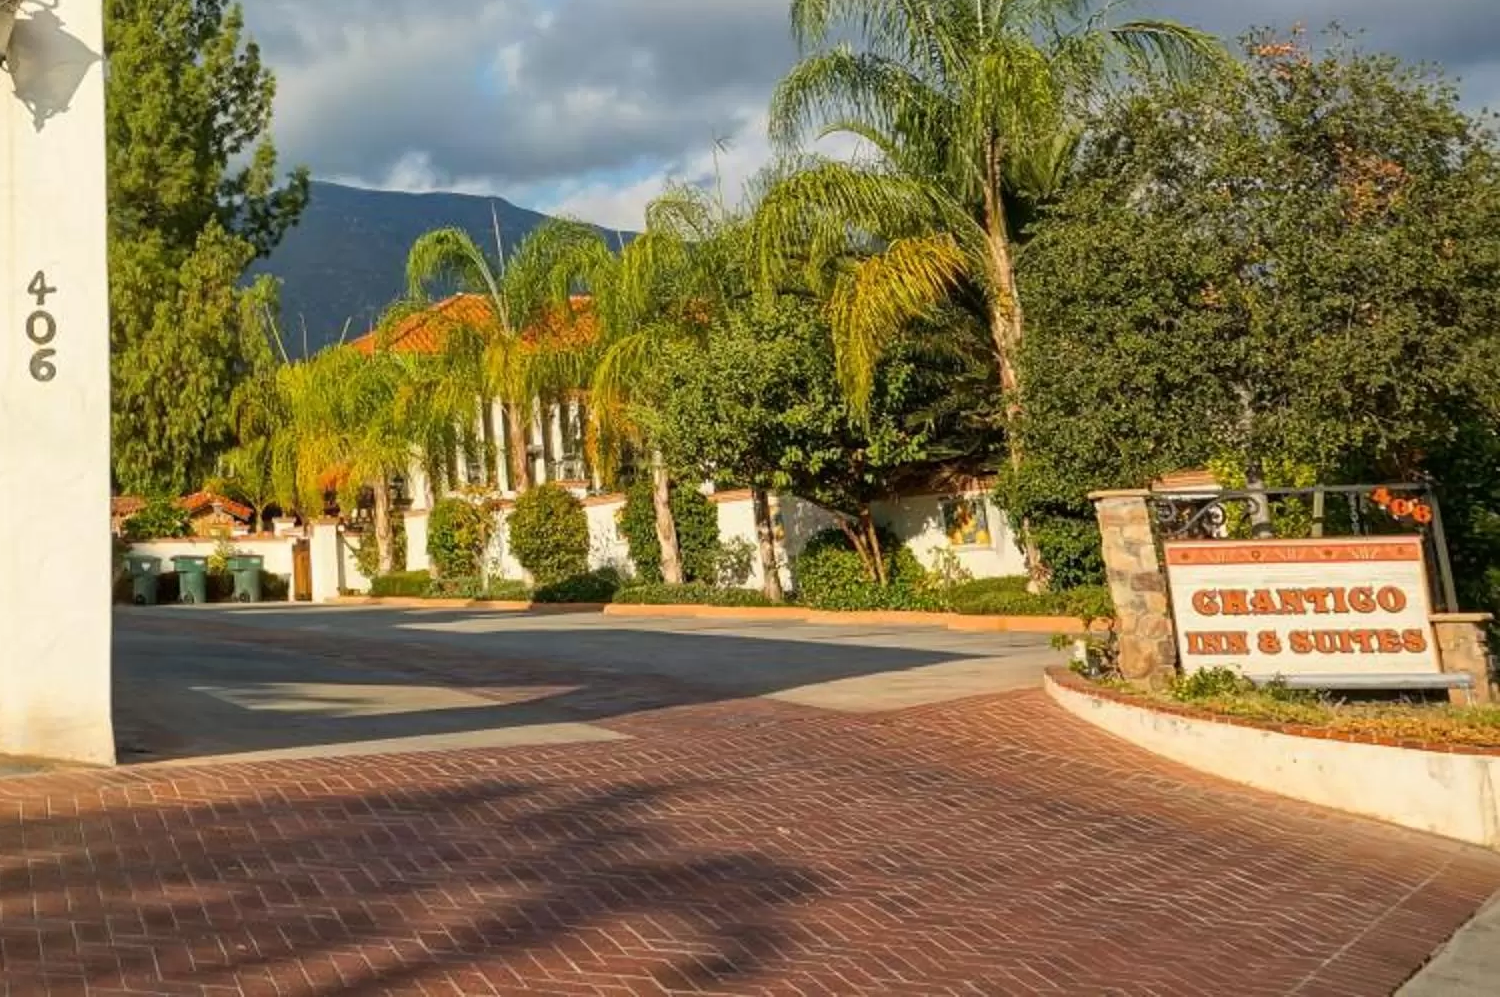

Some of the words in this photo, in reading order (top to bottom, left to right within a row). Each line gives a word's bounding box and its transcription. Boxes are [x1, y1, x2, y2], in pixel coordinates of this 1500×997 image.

[26, 270, 57, 382] 406
[1186, 631, 1250, 655] INN
[1257, 629, 1282, 654] &
[1288, 628, 1427, 654] SUITES
